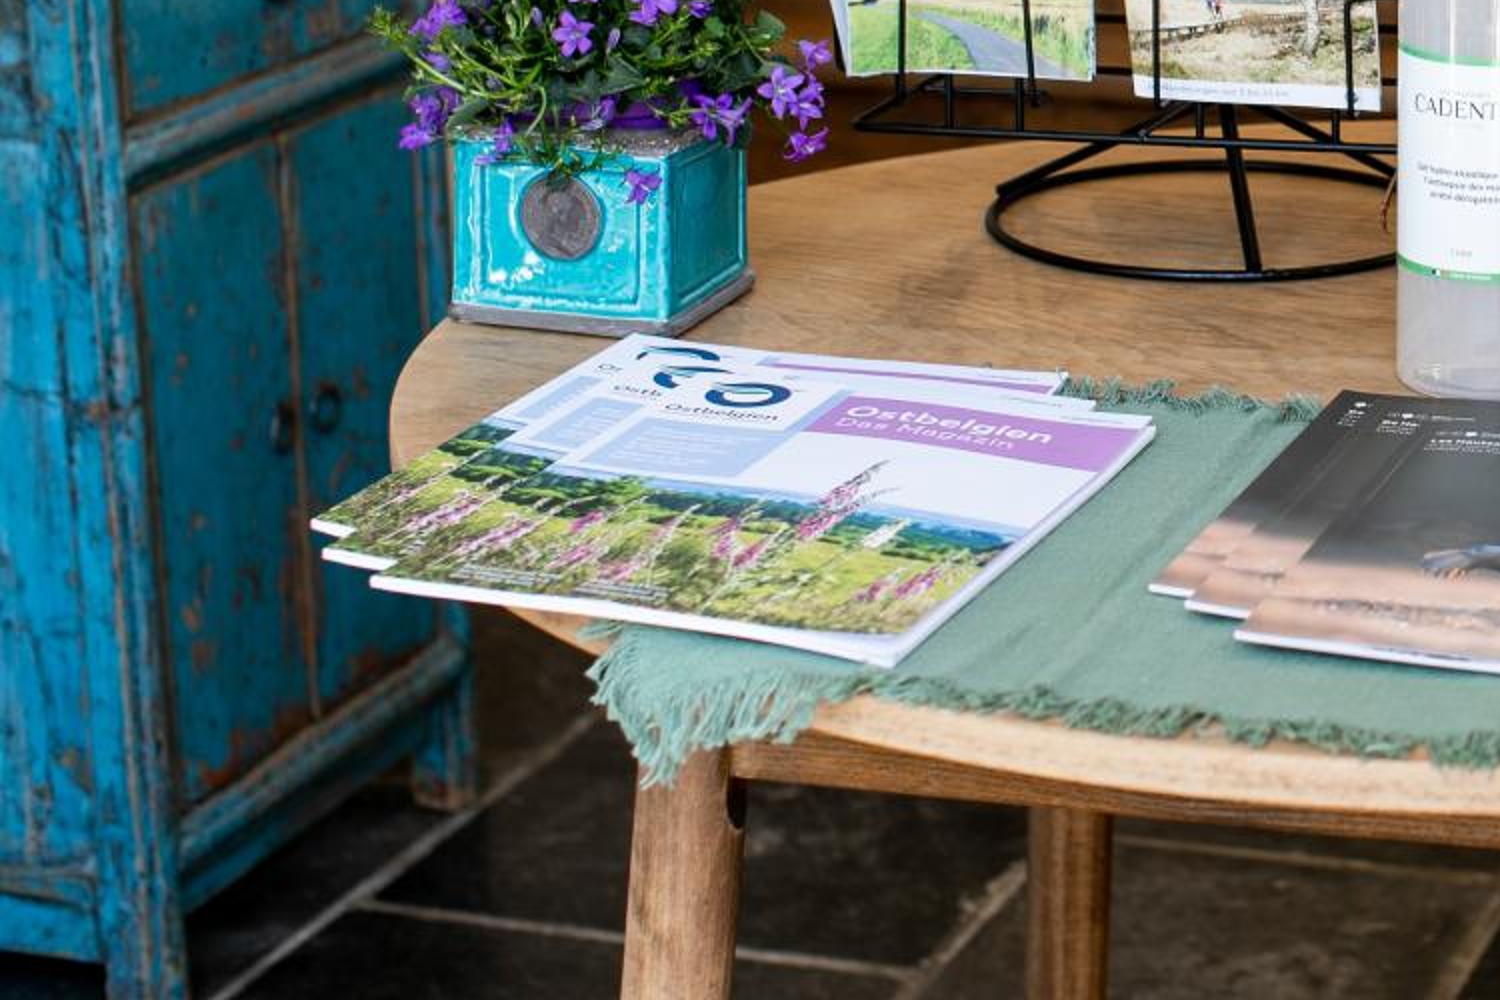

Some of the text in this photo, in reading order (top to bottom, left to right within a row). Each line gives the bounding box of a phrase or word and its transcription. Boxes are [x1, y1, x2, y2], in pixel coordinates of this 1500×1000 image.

[665, 402, 779, 422] Ostbelgien
[848, 405, 1053, 444] Ostbelgien
[835, 417, 1016, 450] Das Magazin
